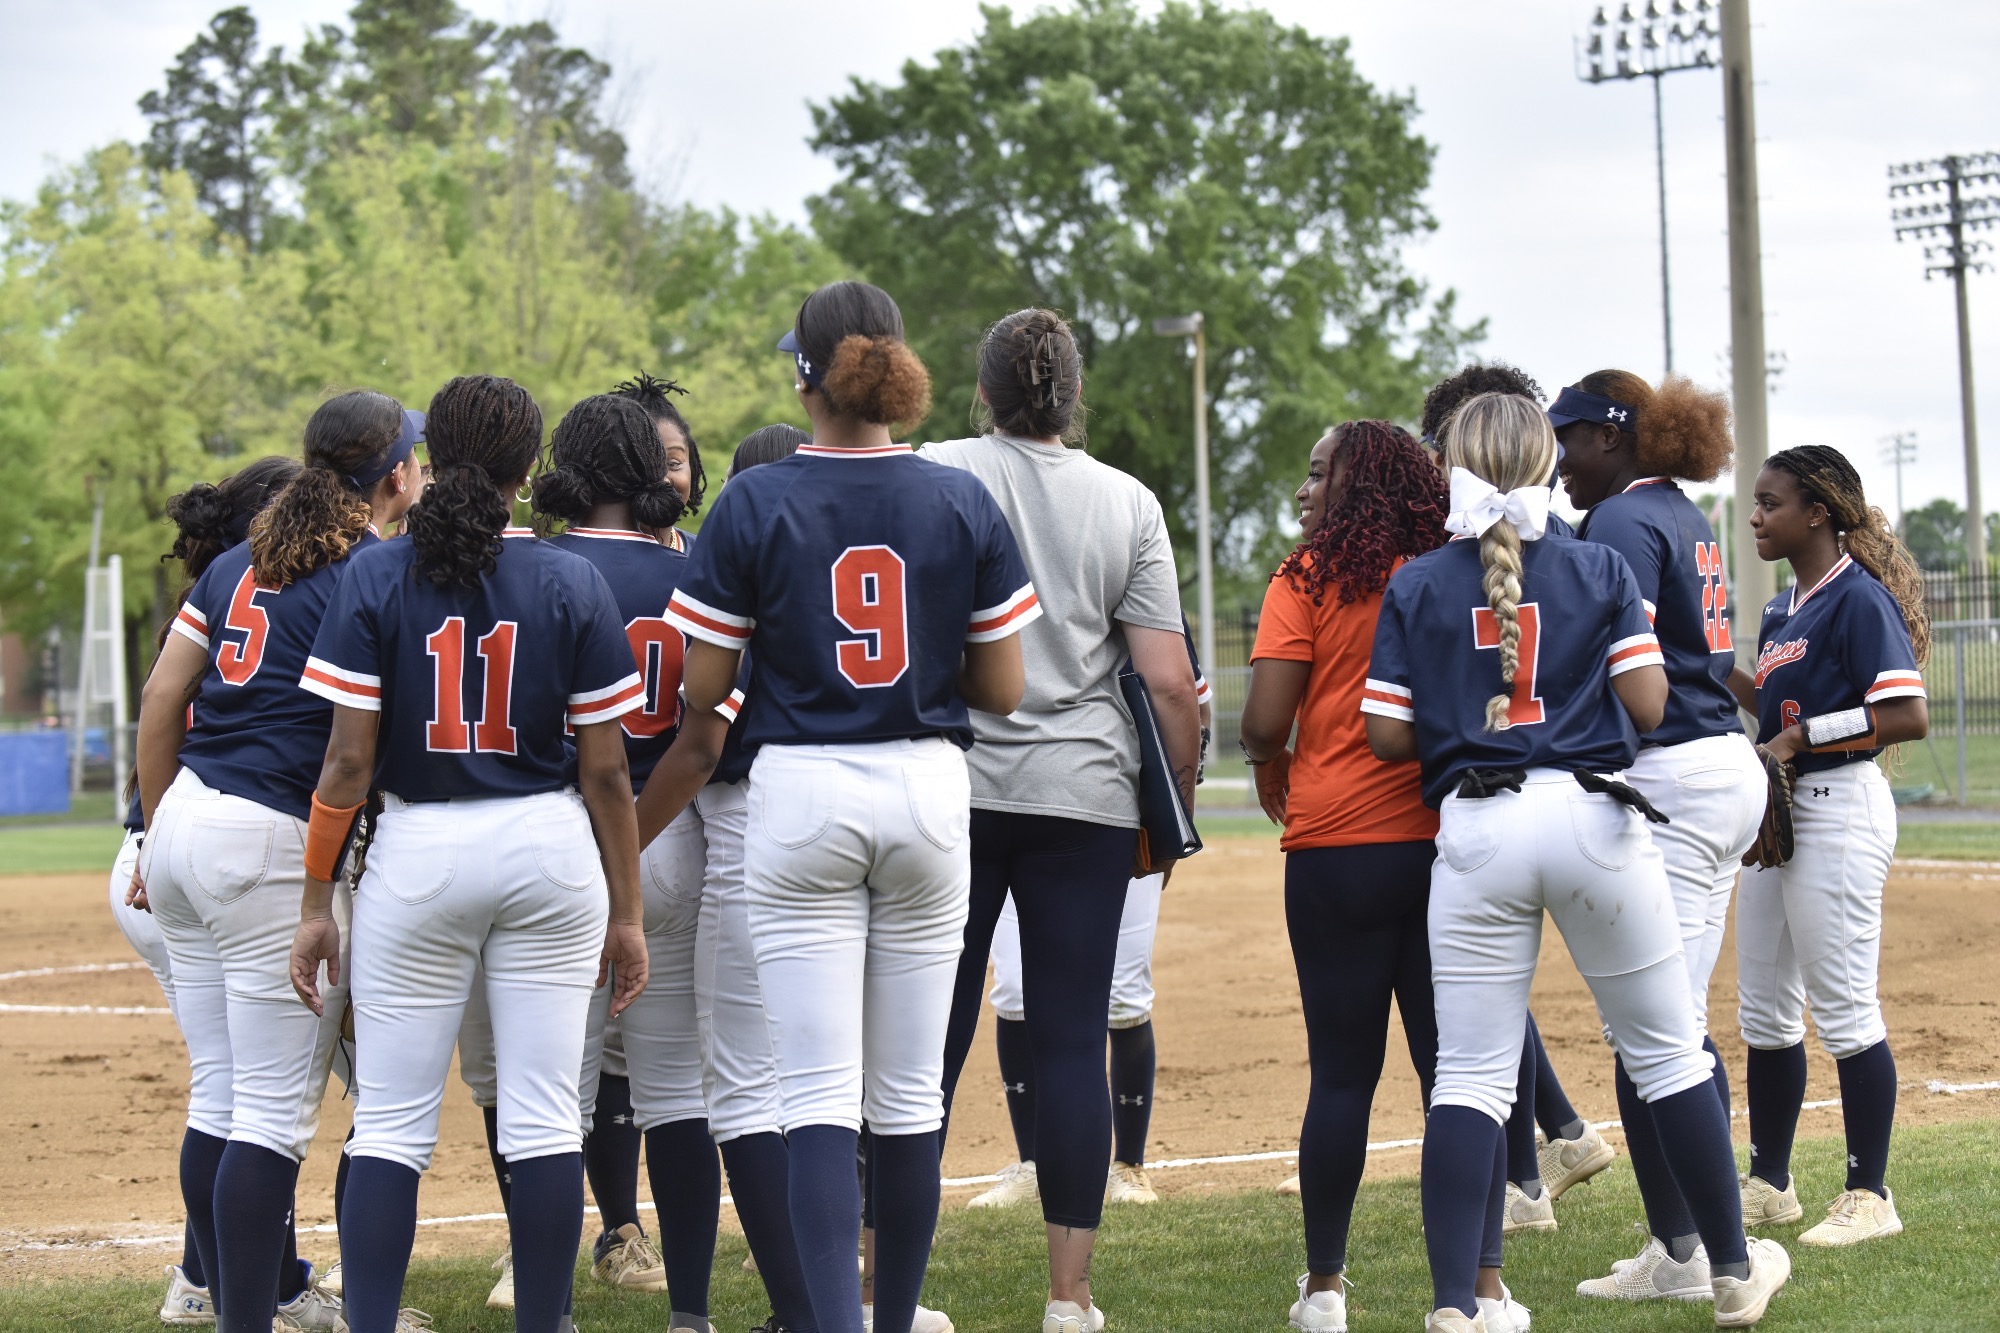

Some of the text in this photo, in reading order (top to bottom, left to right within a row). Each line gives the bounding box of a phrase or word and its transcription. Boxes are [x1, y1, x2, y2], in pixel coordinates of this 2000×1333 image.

[216, 565, 285, 686] 5
[831, 544, 909, 689] 9
[1695, 542, 1734, 653] 22
[426, 616, 518, 756] 11
[1471, 602, 1546, 730] 7
[1780, 699, 1801, 733] 6
